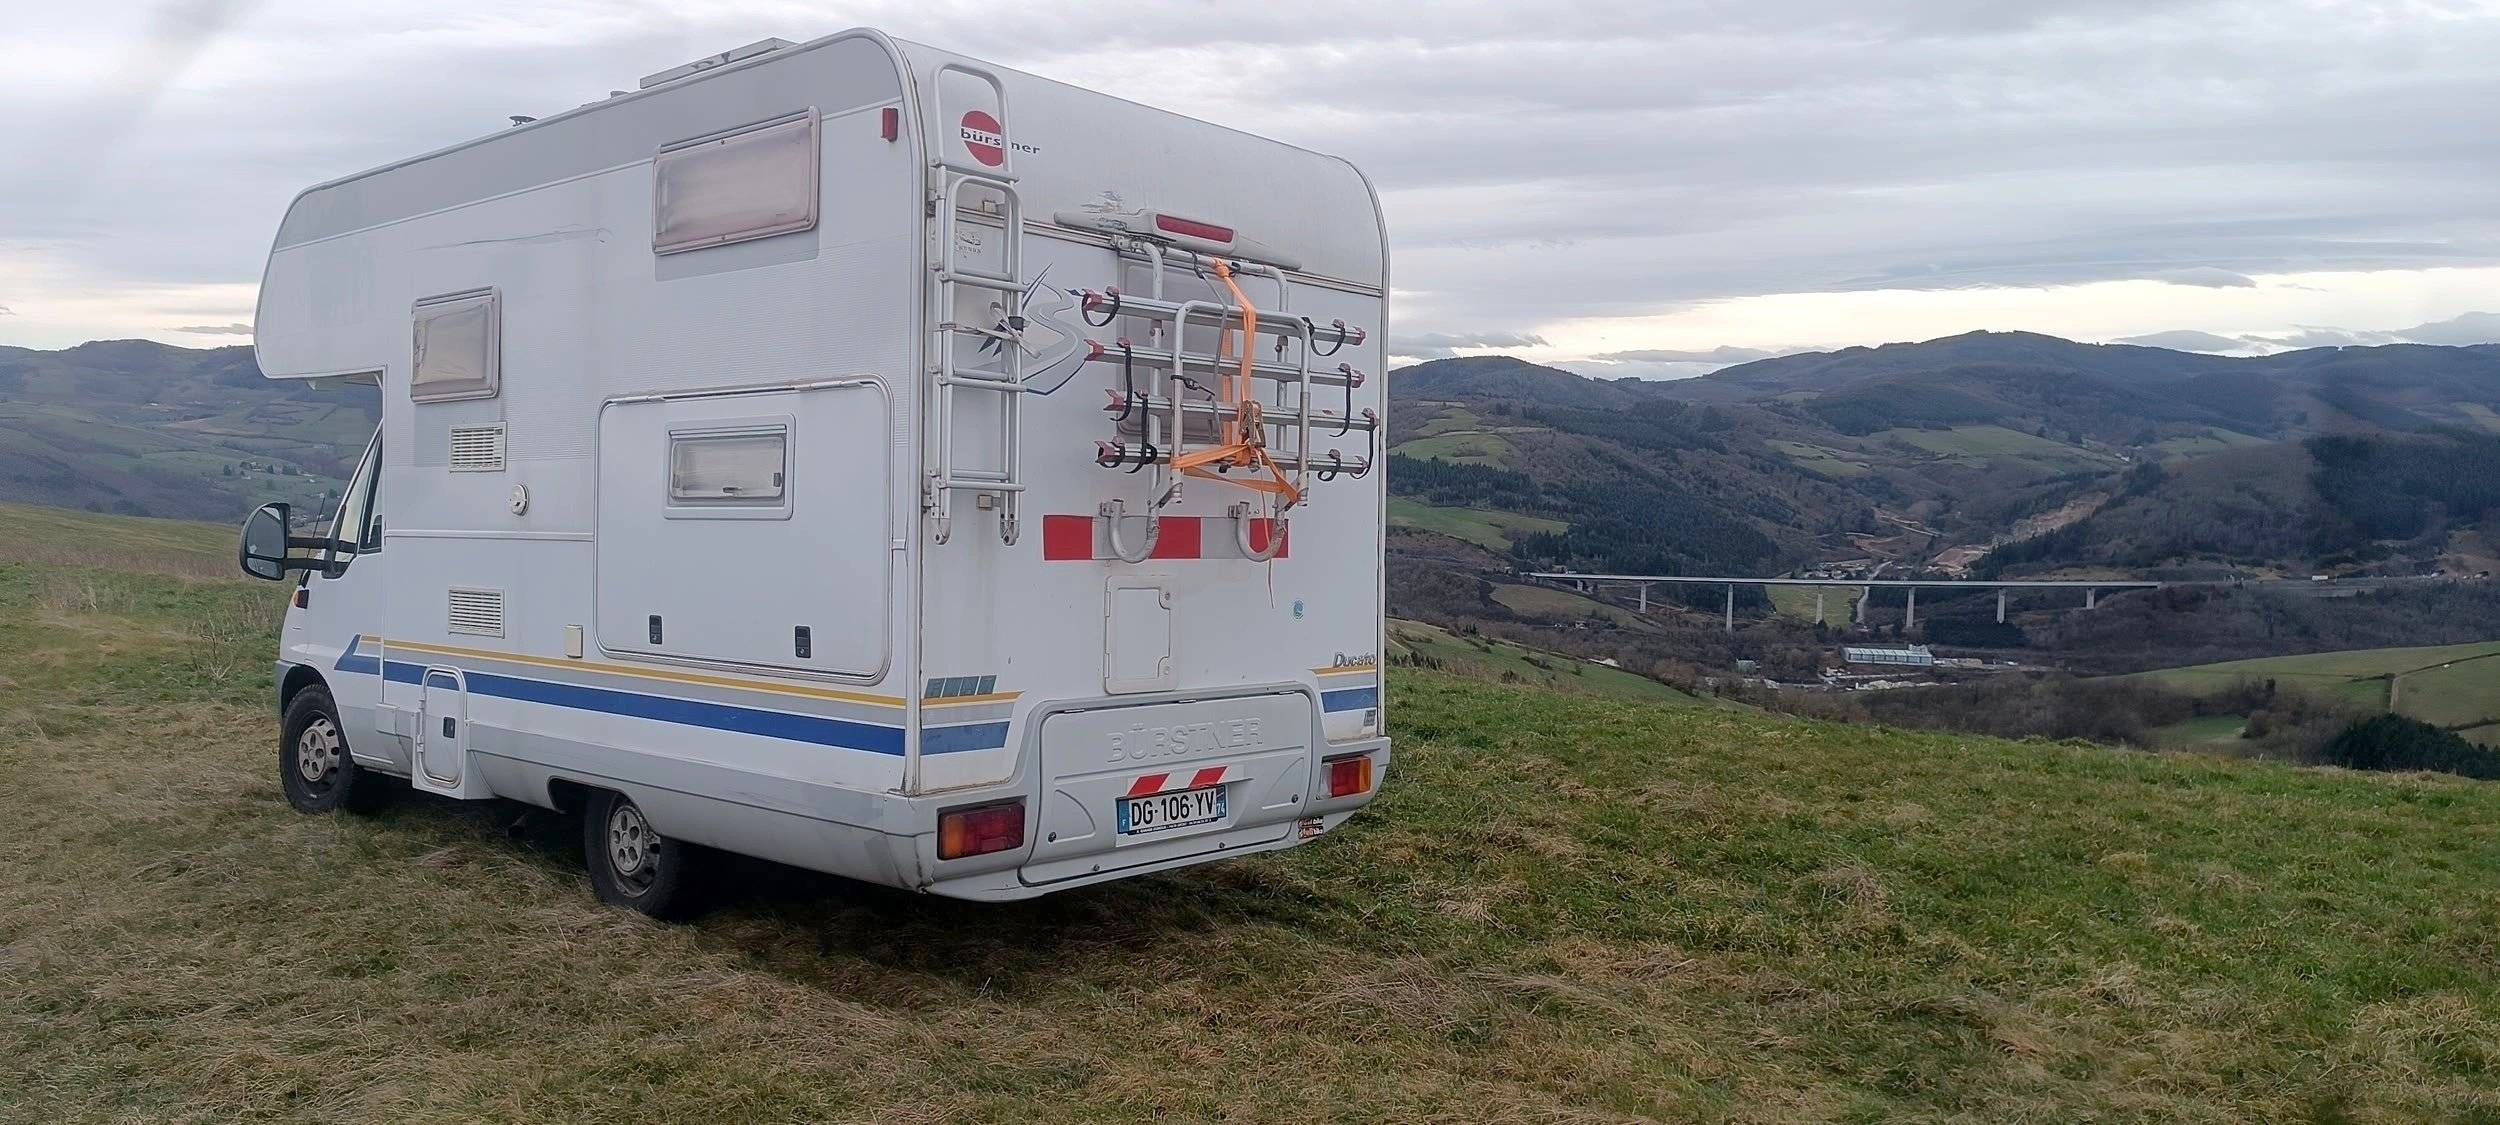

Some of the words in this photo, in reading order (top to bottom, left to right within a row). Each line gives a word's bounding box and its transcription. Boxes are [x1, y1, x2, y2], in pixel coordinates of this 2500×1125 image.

[960, 128, 1040, 154] bürsner
[1332, 652, 1376, 668] Ducato
[1106, 718, 1264, 763] BÜRSTNER
[1216, 802, 1226, 815] 74
